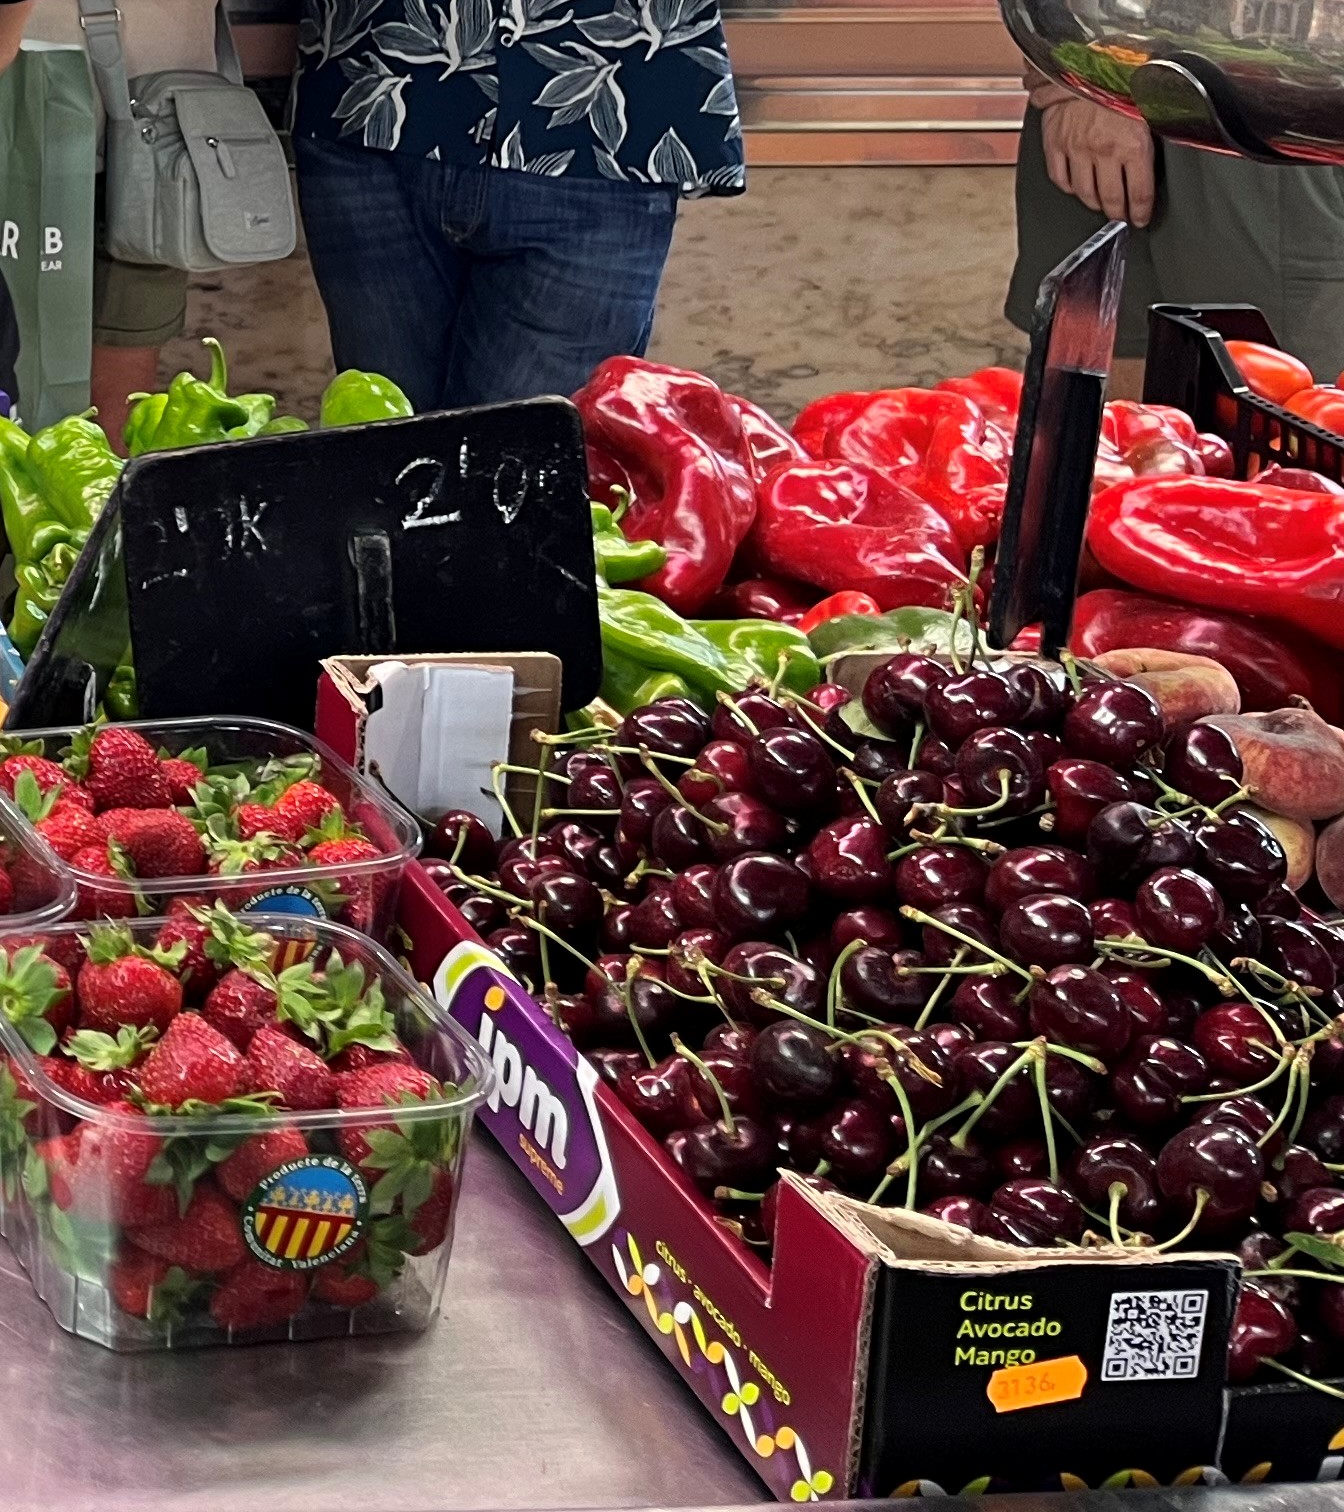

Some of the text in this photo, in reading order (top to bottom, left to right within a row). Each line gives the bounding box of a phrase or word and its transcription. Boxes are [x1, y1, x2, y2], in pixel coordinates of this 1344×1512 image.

[478, 985, 566, 1170] ipm
[259, 1157, 320, 1190] Producte
[322, 1157, 339, 1169] de
[519, 1133, 564, 1196] supreme
[243, 1215, 360, 1269] Comunitat Valenciana
[655, 1240, 791, 1406] citrus avocado mango
[960, 1291, 1033, 1312] Citrus
[956, 1317, 1062, 1339] Avocado
[954, 1346, 1036, 1368] Mango
